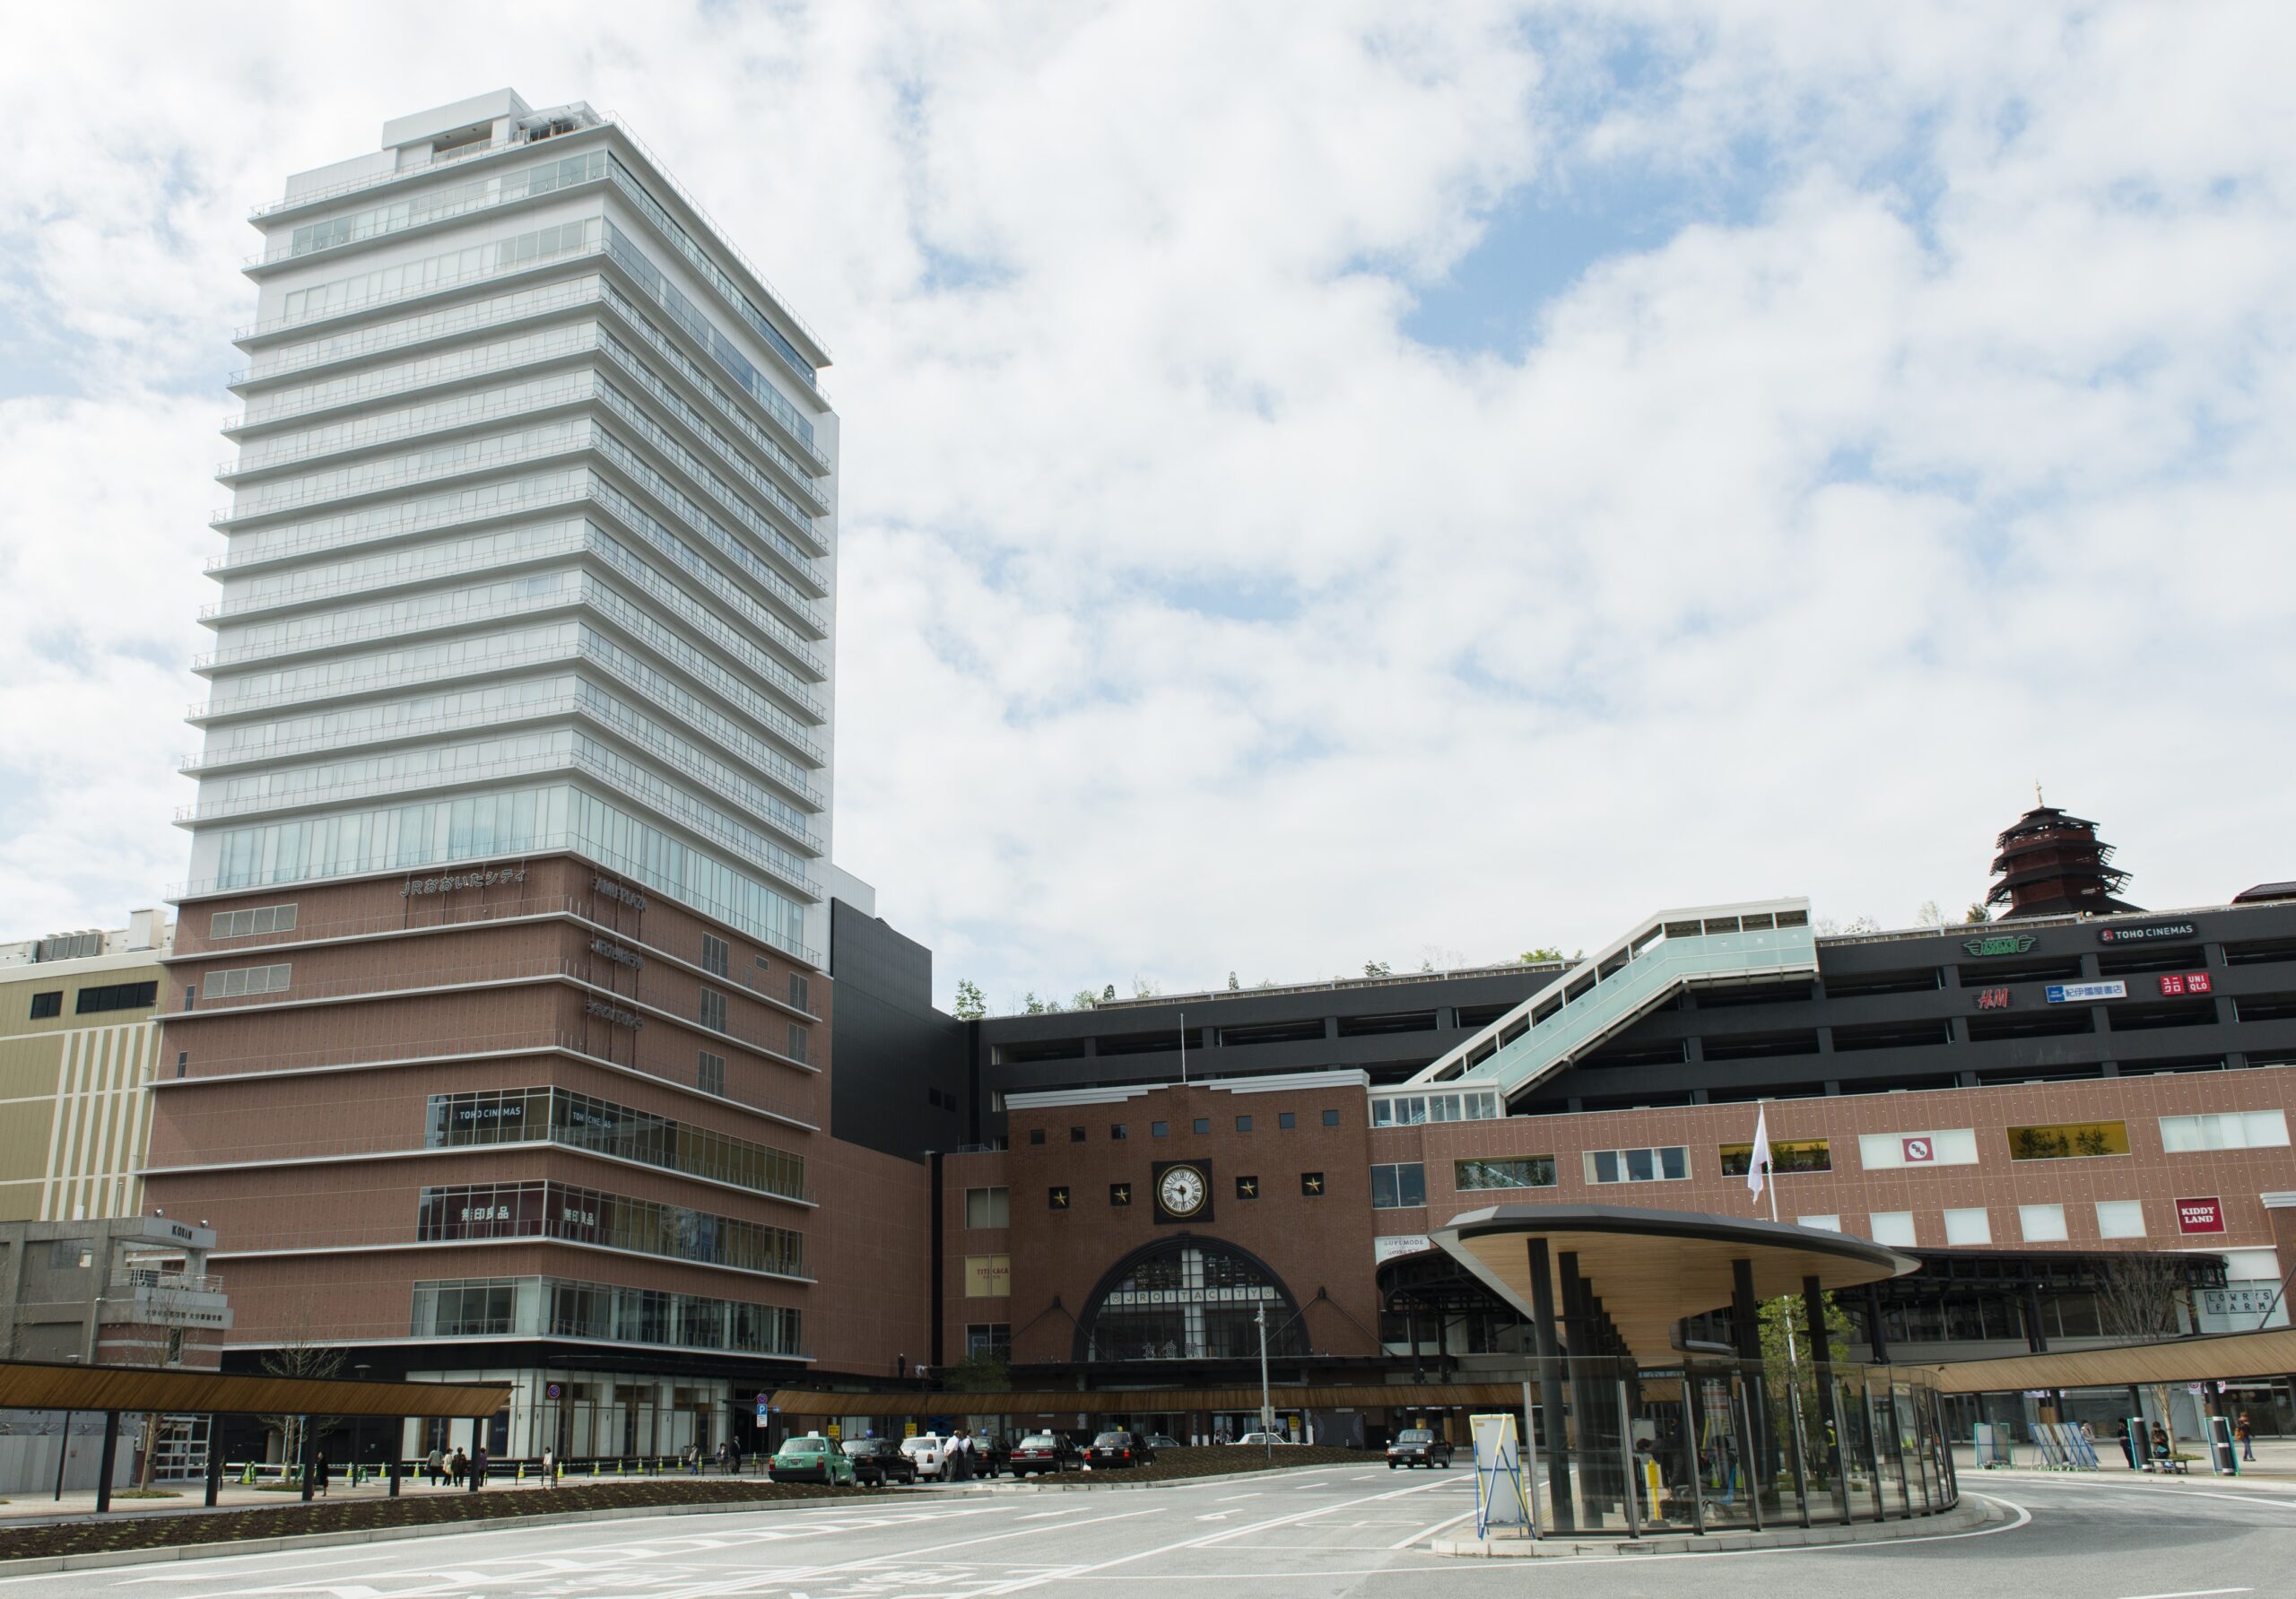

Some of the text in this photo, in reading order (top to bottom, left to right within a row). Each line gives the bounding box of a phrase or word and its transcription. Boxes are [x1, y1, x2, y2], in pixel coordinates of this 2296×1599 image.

[400, 869, 526, 897] JRおおいたシティ
[2116, 925, 2193, 939] TOHO CINEMAS
[2188, 975, 2205, 983] UNI
[2190, 982, 2207, 992] QLO
[483, 1107, 521, 1118] CINMAS
[572, 1111, 612, 1128] TOH CINEAS
[2181, 1206, 2214, 1215] KIDDY
[2184, 1214, 2214, 1223] LAND
[2215, 1301, 2266, 1311] FARM
